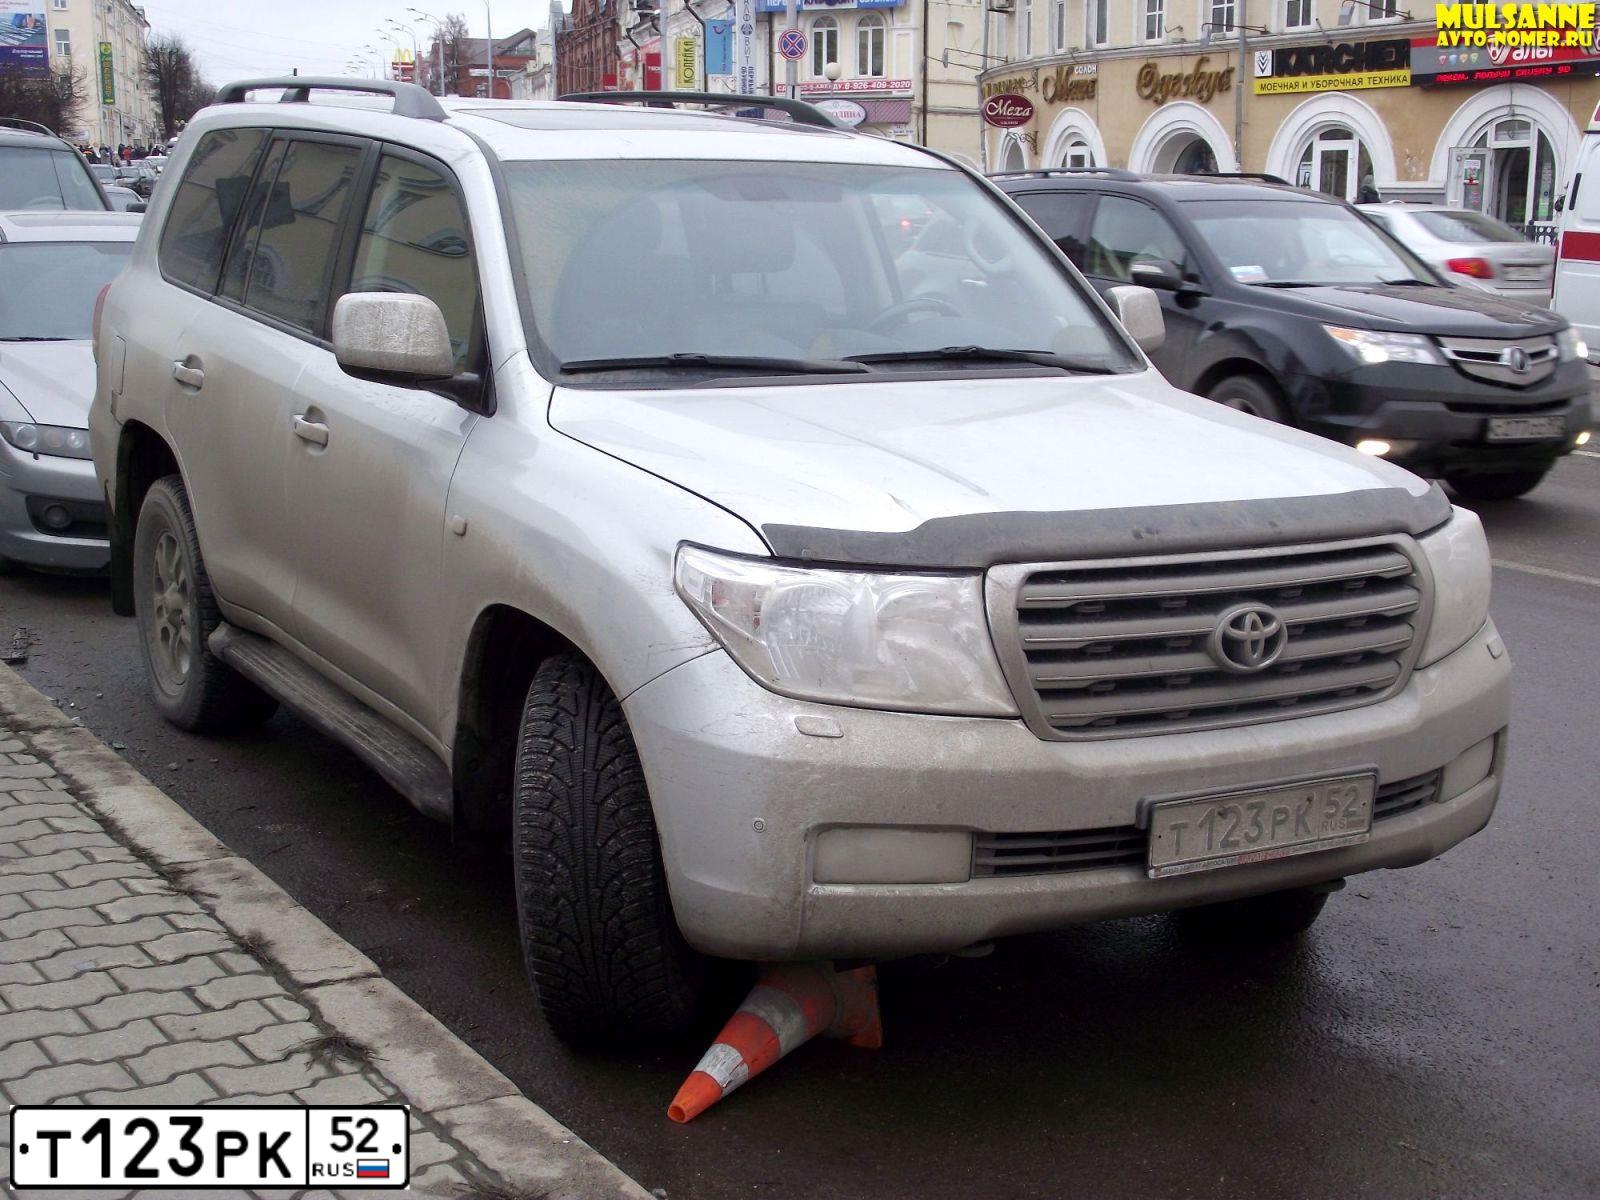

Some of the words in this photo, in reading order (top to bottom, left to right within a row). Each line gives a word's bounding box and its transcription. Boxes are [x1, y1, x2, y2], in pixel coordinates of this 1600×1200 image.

[1260, 81, 1300, 92] МОЕЧНАЯ
[1302, 80, 1308, 89] И
[1311, 77, 1363, 89] УБОРОЧНАЯ
[1368, 74, 1408, 86] ТЕХНИКА
[986, 98, 1032, 117] Меха
[1327, 784, 1359, 819] 52
[1322, 819, 1346, 832] RUS
